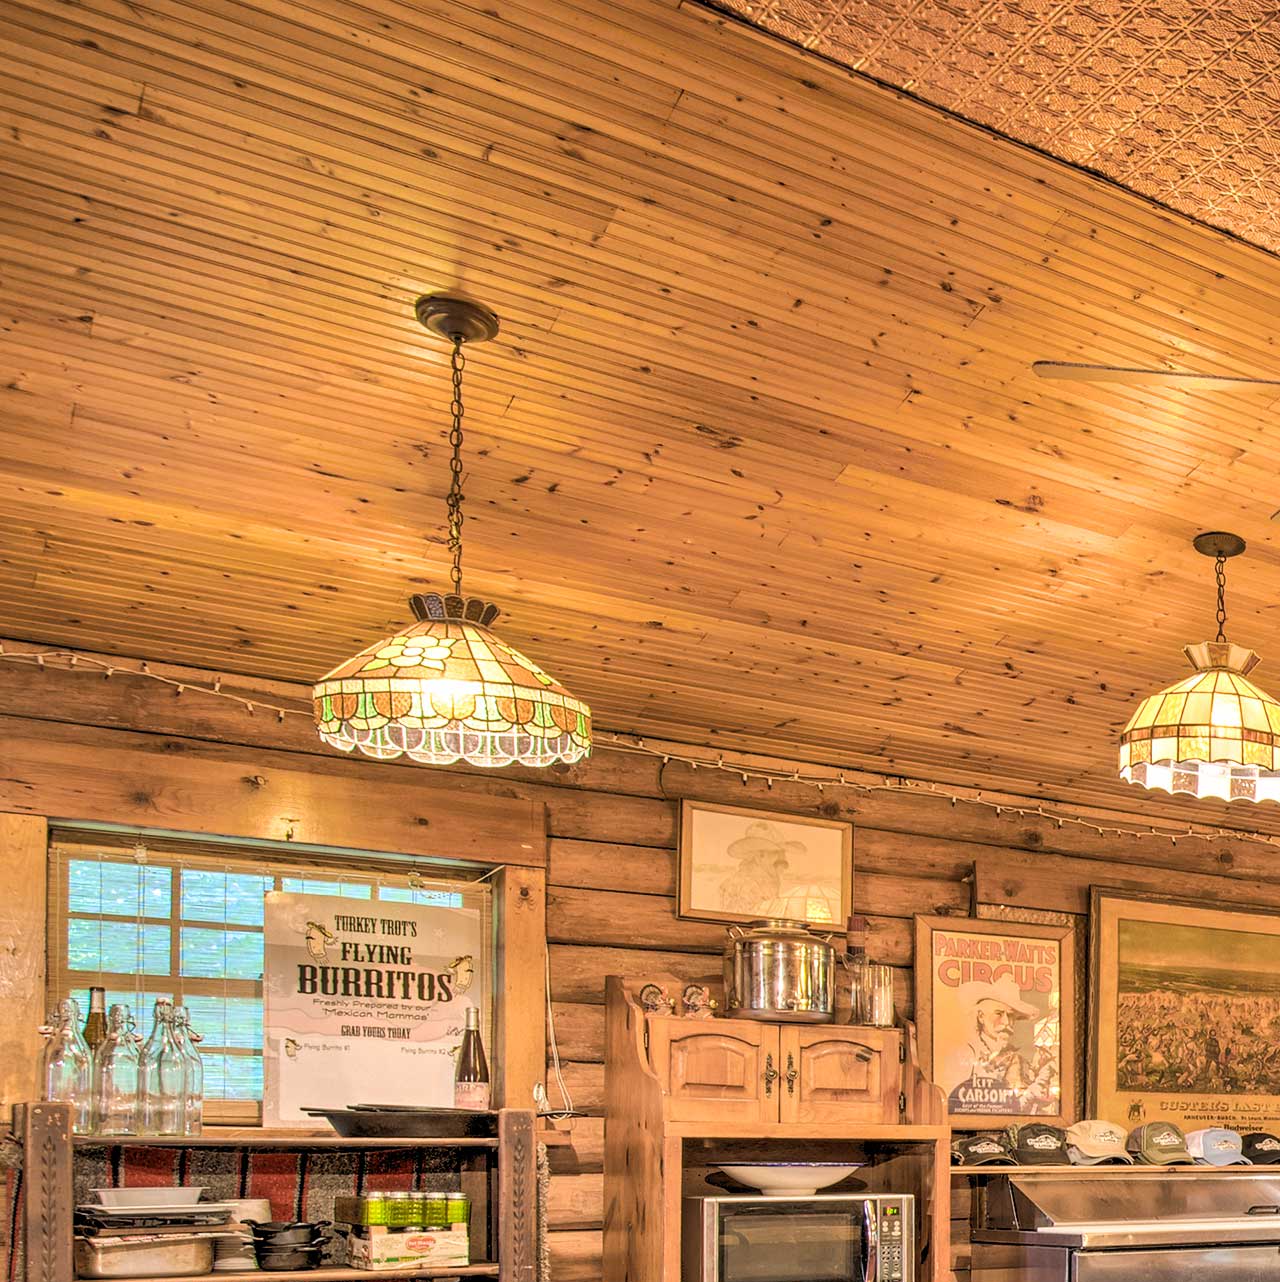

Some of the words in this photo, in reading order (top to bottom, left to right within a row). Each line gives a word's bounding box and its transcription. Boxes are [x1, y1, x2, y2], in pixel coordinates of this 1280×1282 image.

[334, 914, 378, 934] TURKEY
[380, 918, 418, 938] TROT'S
[341, 942, 413, 966] FLYING
[934, 932, 1056, 965] PARKER-WATTS
[297, 964, 453, 1002] BURRITOS
[938, 959, 1053, 993] CIRCUS
[313, 999, 349, 1008] Freshly
[352, 1000, 398, 1010] Prepared
[401, 1003, 414, 1011] by
[341, 1025, 361, 1037] GRAB
[363, 1026, 386, 1038] YOURS
[387, 1027, 411, 1039] TODAY
[958, 1087, 1010, 1103] CARSON
[1160, 1101, 1230, 1113] CUSTER'S
[1232, 1102, 1271, 1113] LAST
[1224, 1124, 1264, 1132] Budweiser
